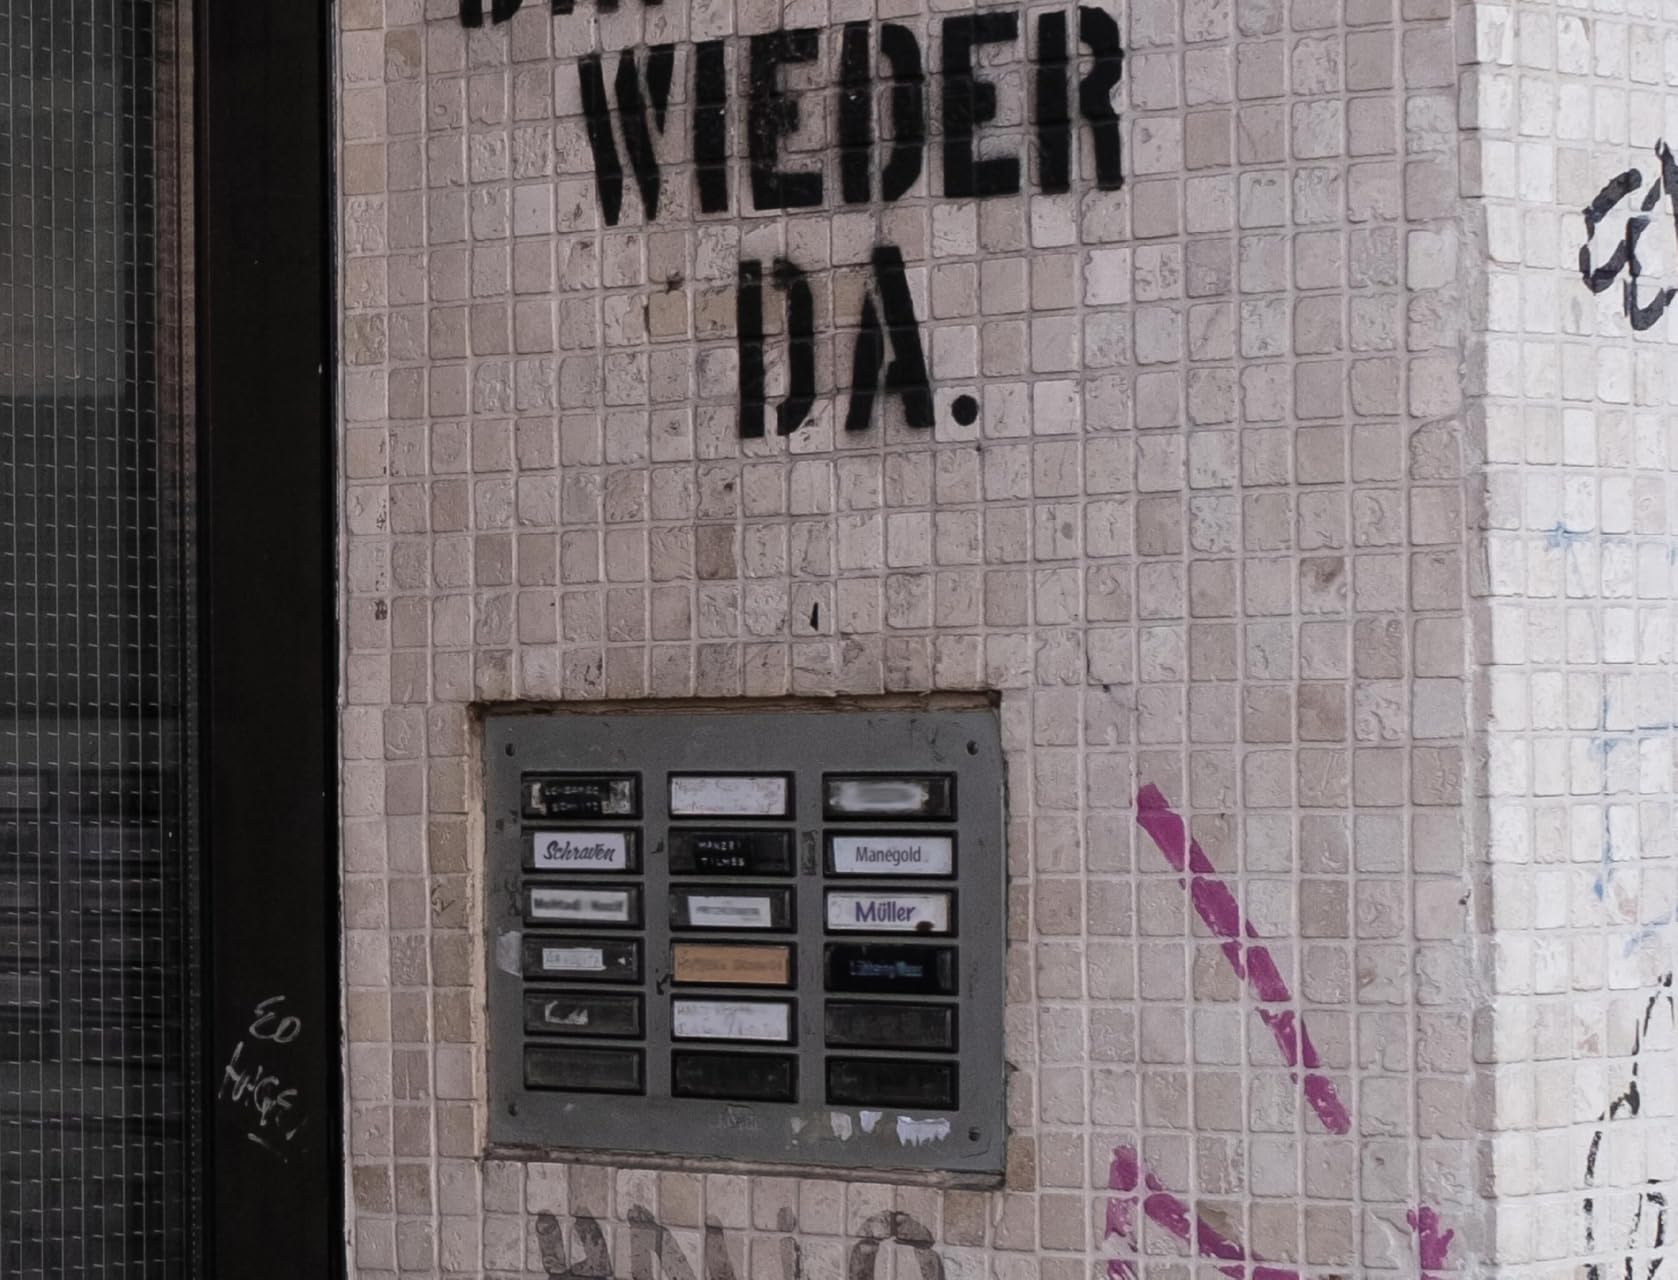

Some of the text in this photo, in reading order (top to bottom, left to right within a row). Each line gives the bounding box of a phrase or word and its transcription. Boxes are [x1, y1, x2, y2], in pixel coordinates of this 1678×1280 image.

[577, 6, 1126, 227] WIEDER
[738, 245, 978, 440] DA.
[544, 840, 616, 862] Schraven
[855, 846, 921, 866] Manegold
[855, 901, 916, 923] Müller
